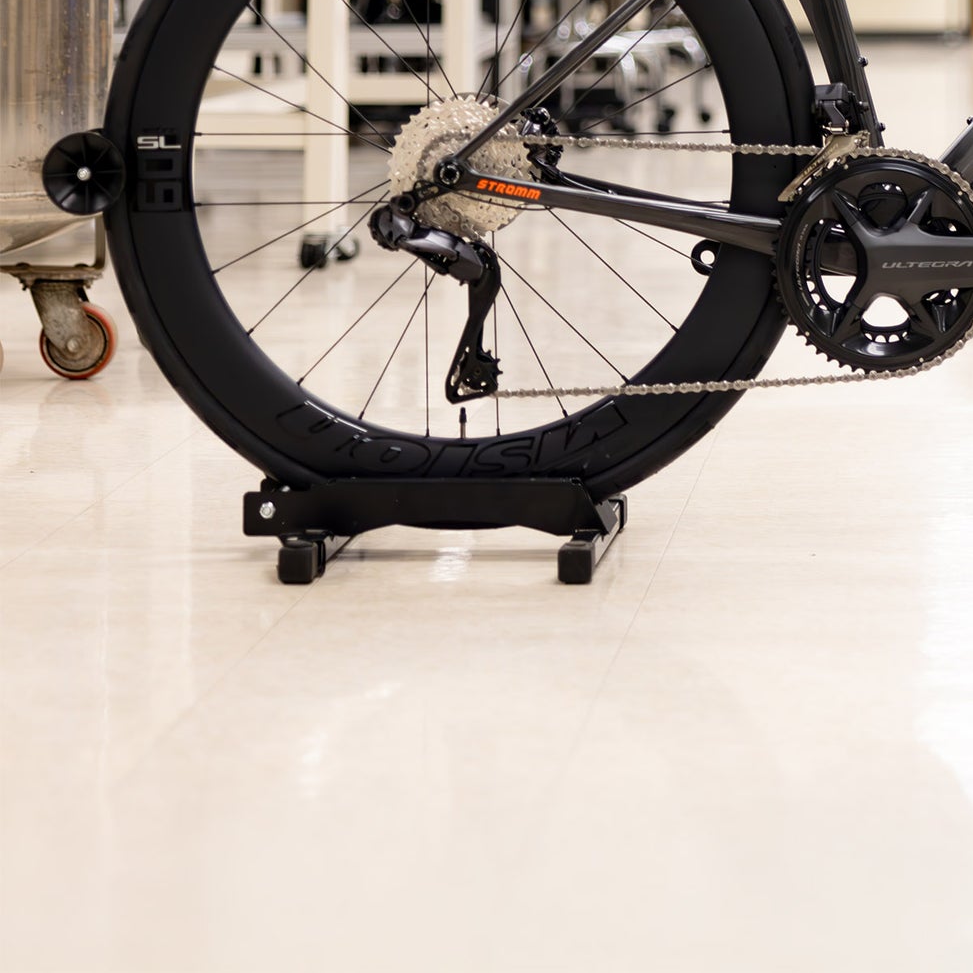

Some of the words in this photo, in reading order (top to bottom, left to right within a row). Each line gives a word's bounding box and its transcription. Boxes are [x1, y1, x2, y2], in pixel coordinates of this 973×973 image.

[136, 135, 182, 149] SL
[476, 178, 542, 201] STROMM
[881, 259, 973, 270] ULTEGRA
